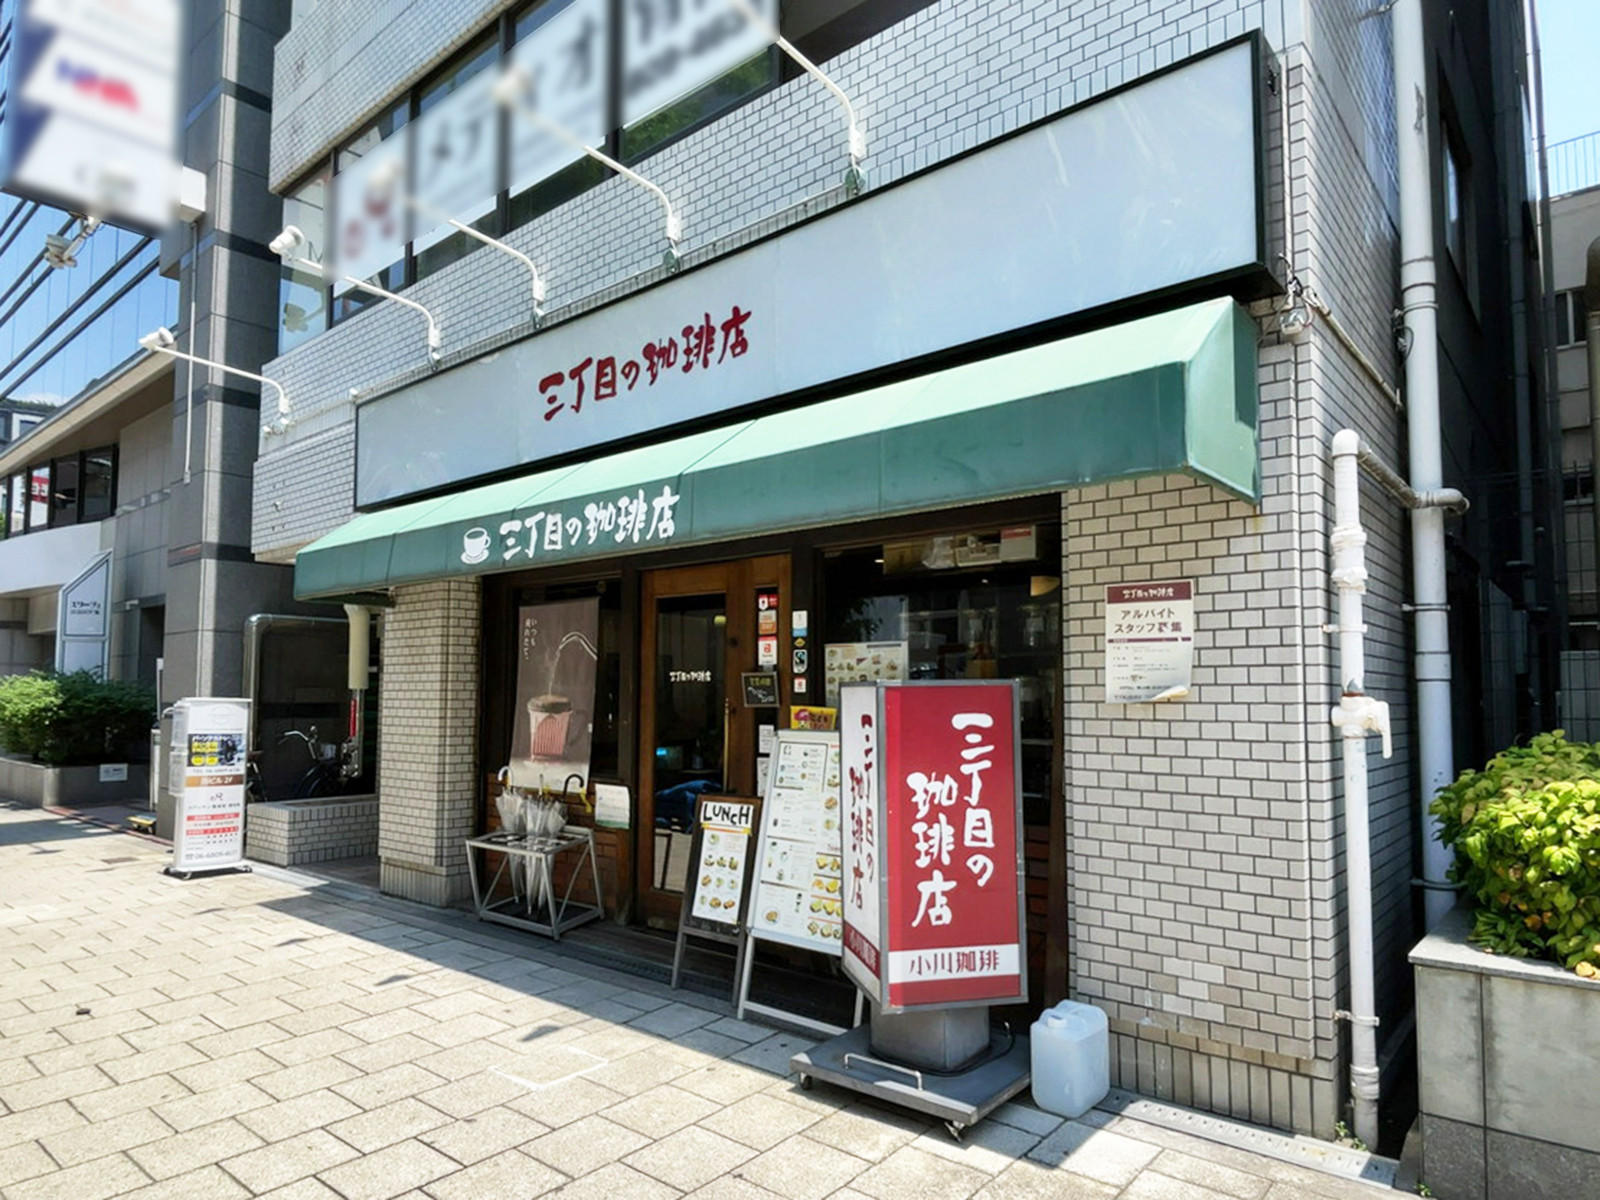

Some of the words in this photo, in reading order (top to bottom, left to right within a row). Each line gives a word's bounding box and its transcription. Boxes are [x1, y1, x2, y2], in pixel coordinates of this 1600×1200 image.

[539, 306, 752, 421] 三丁目の珈琲店
[500, 485, 681, 560] 三丁目の珈琲店
[1121, 607, 1175, 620] アルバイト
[703, 802, 750, 826] LUNCH
[849, 766, 864, 910] 珈琲店
[861, 714, 874, 882] 三丁目の
[906, 772, 958, 927] 珈琲店
[951, 712, 995, 887] 三丁目の
[909, 949, 1000, 975] 小川珈琲
